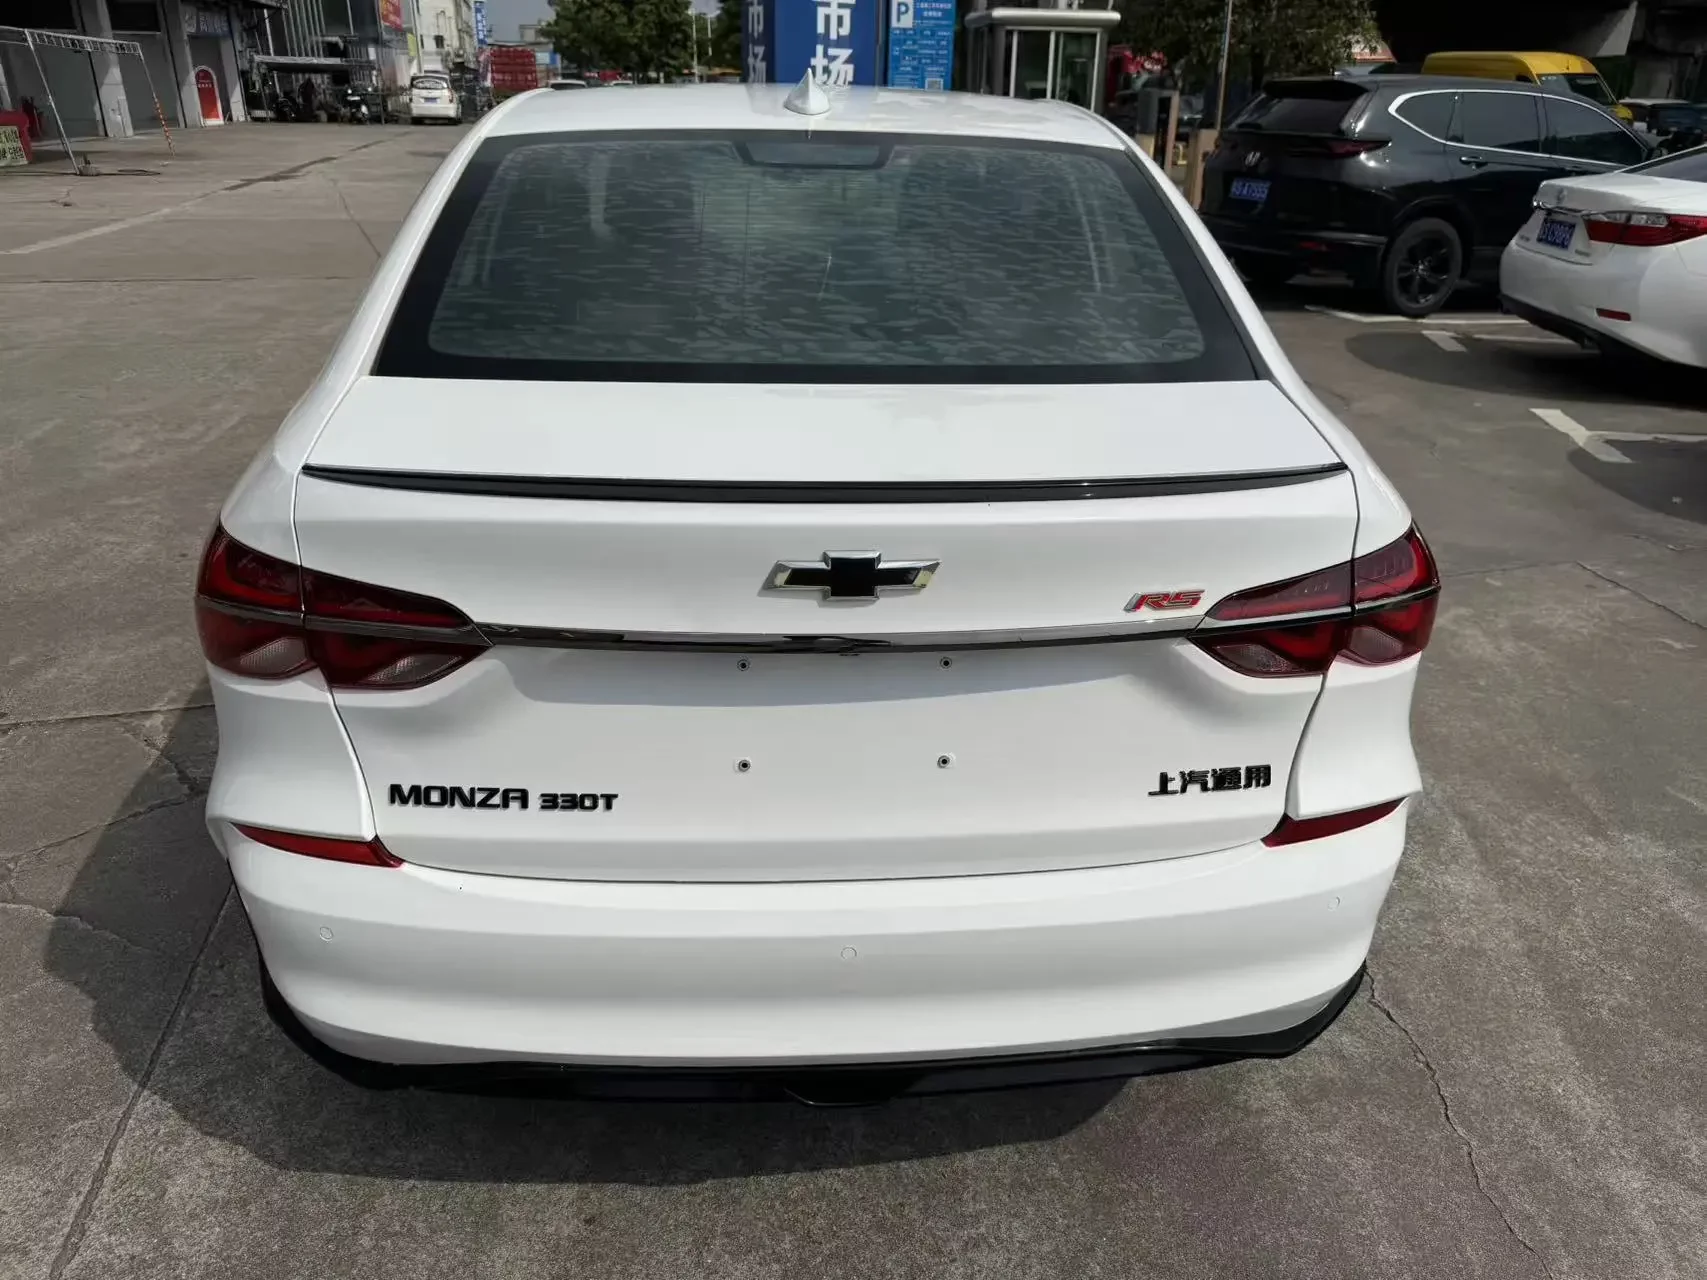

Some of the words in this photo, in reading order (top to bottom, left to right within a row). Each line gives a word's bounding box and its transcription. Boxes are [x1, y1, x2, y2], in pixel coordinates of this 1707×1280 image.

[896, 1, 910, 25] P
[810, 0, 857, 86] 市场
[1131, 588, 1205, 613] RS
[1147, 763, 1272, 797] 上汽通用
[389, 783, 530, 810] MONZA
[539, 792, 619, 811] 330T
